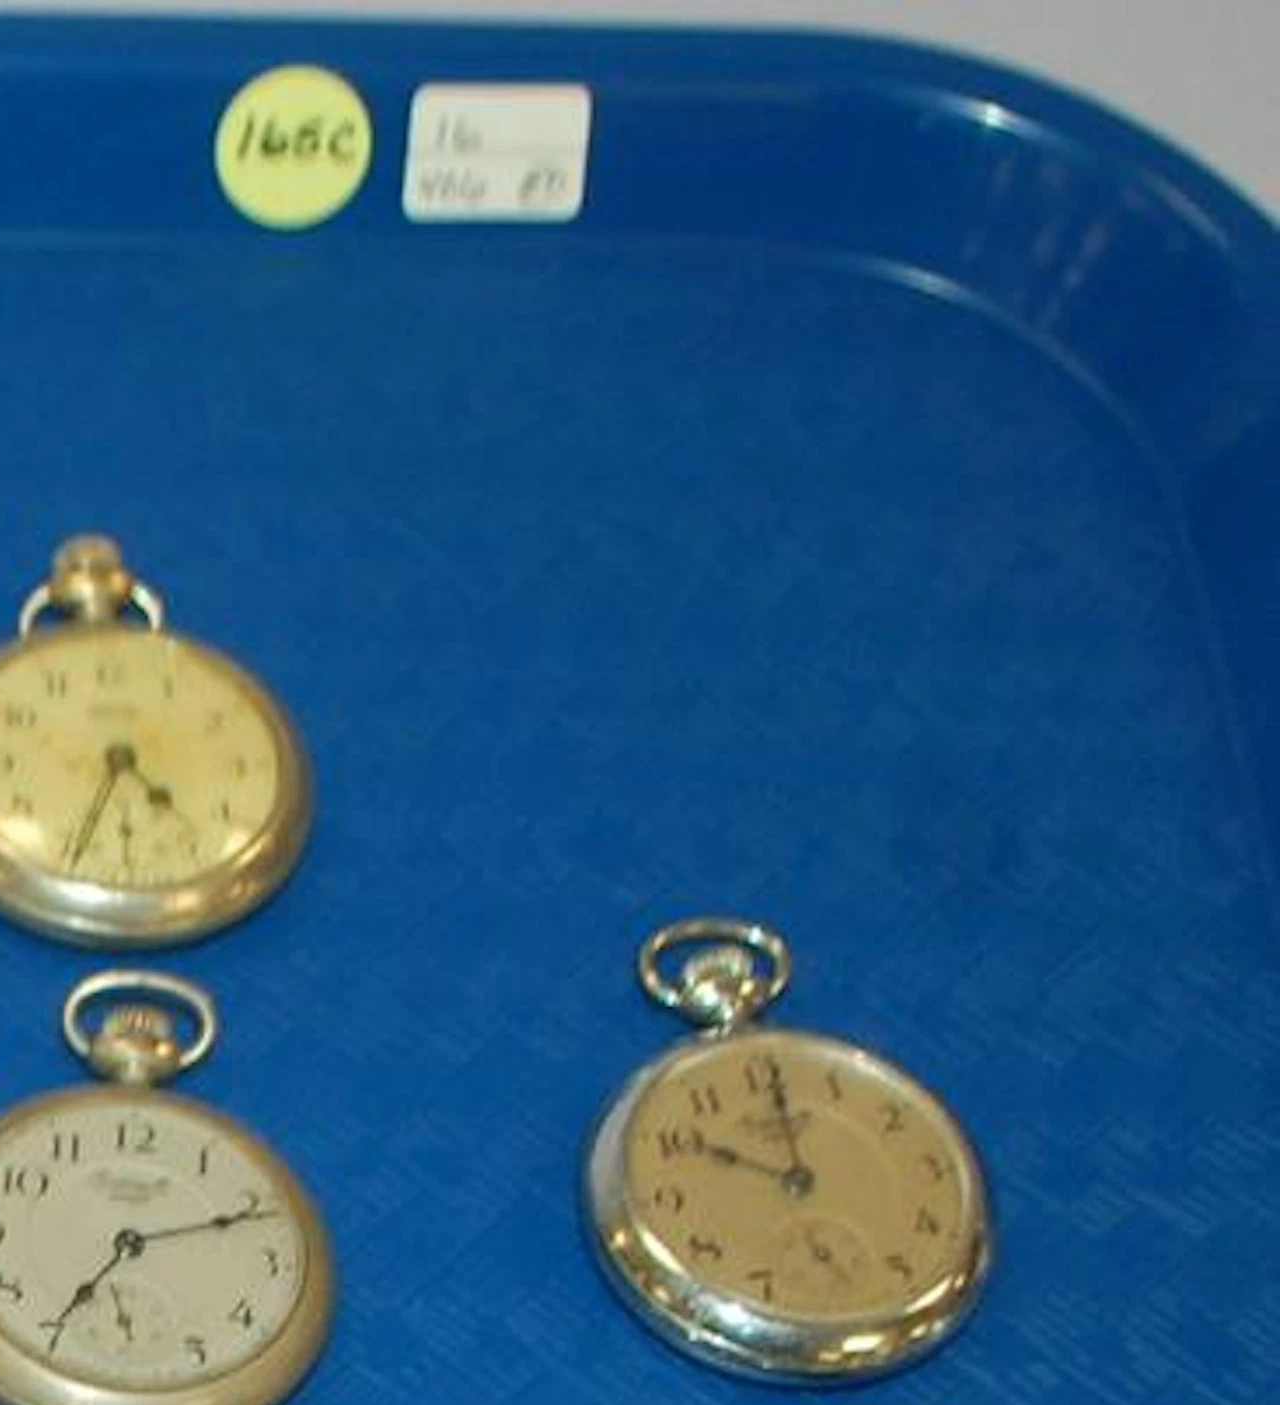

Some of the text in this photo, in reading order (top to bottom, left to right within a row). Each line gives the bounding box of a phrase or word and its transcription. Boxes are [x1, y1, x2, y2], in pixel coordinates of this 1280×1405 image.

[745, 1058, 780, 1093] 12
[827, 1072, 842, 1101] 1
[690, 1087, 721, 1116] 11
[878, 1106, 903, 1133] 2
[54, 1133, 79, 1164] 11
[117, 1123, 155, 1153] 12
[658, 1128, 704, 1159] 10
[199, 1147, 207, 1175] 1
[920, 1156, 943, 1180] 3
[4, 1170, 48, 1196] 10
[915, 1208, 939, 1236] 4
[747, 1269, 772, 1301] 7
[228, 1299, 252, 1328] 4
